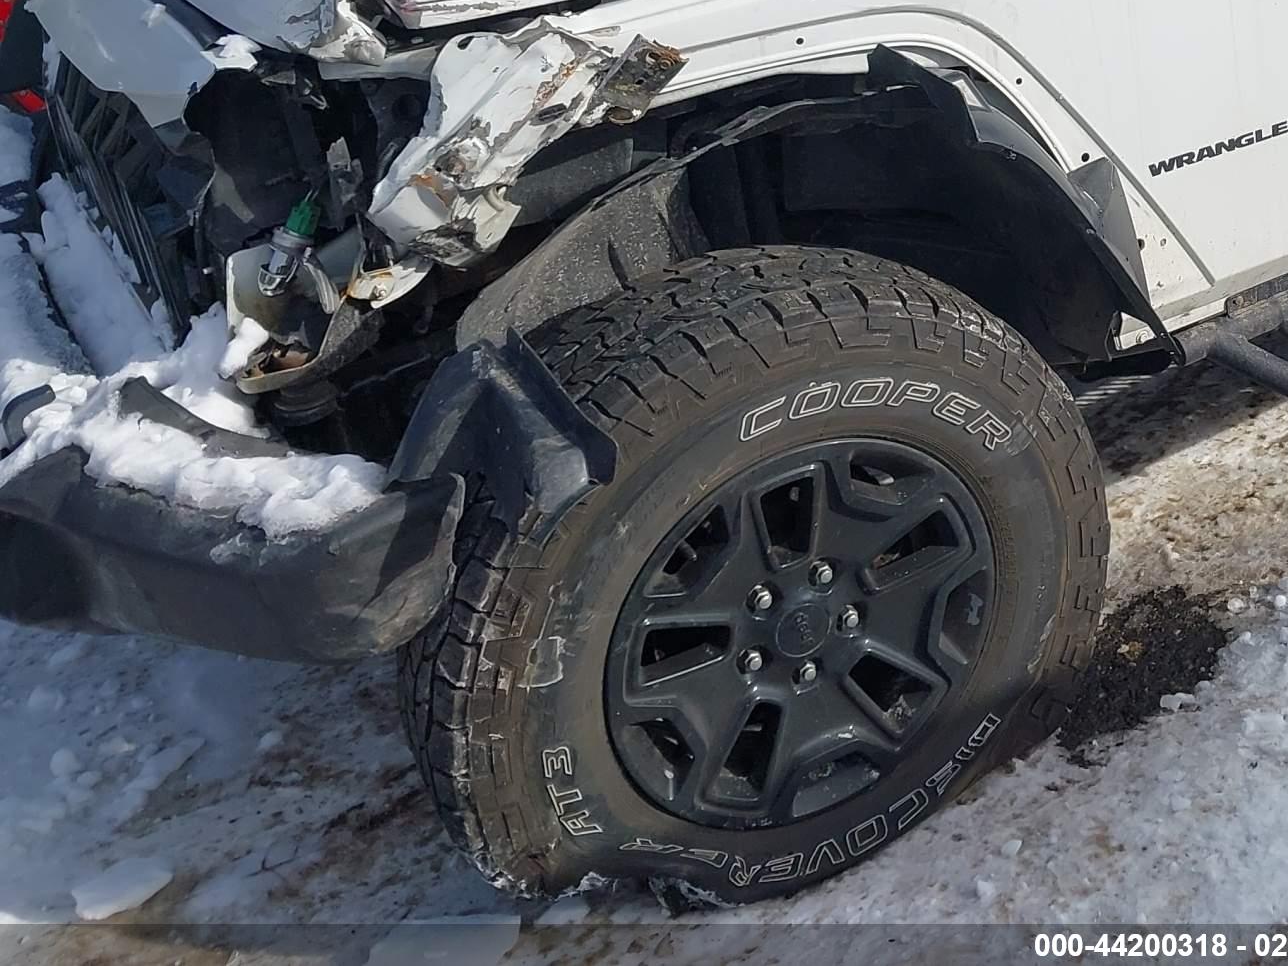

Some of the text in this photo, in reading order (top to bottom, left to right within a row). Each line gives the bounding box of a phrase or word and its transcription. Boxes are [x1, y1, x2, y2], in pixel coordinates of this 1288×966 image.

[739, 377, 1012, 451] COOPER
[542, 713, 1001, 887] DISCOVERER AT3
